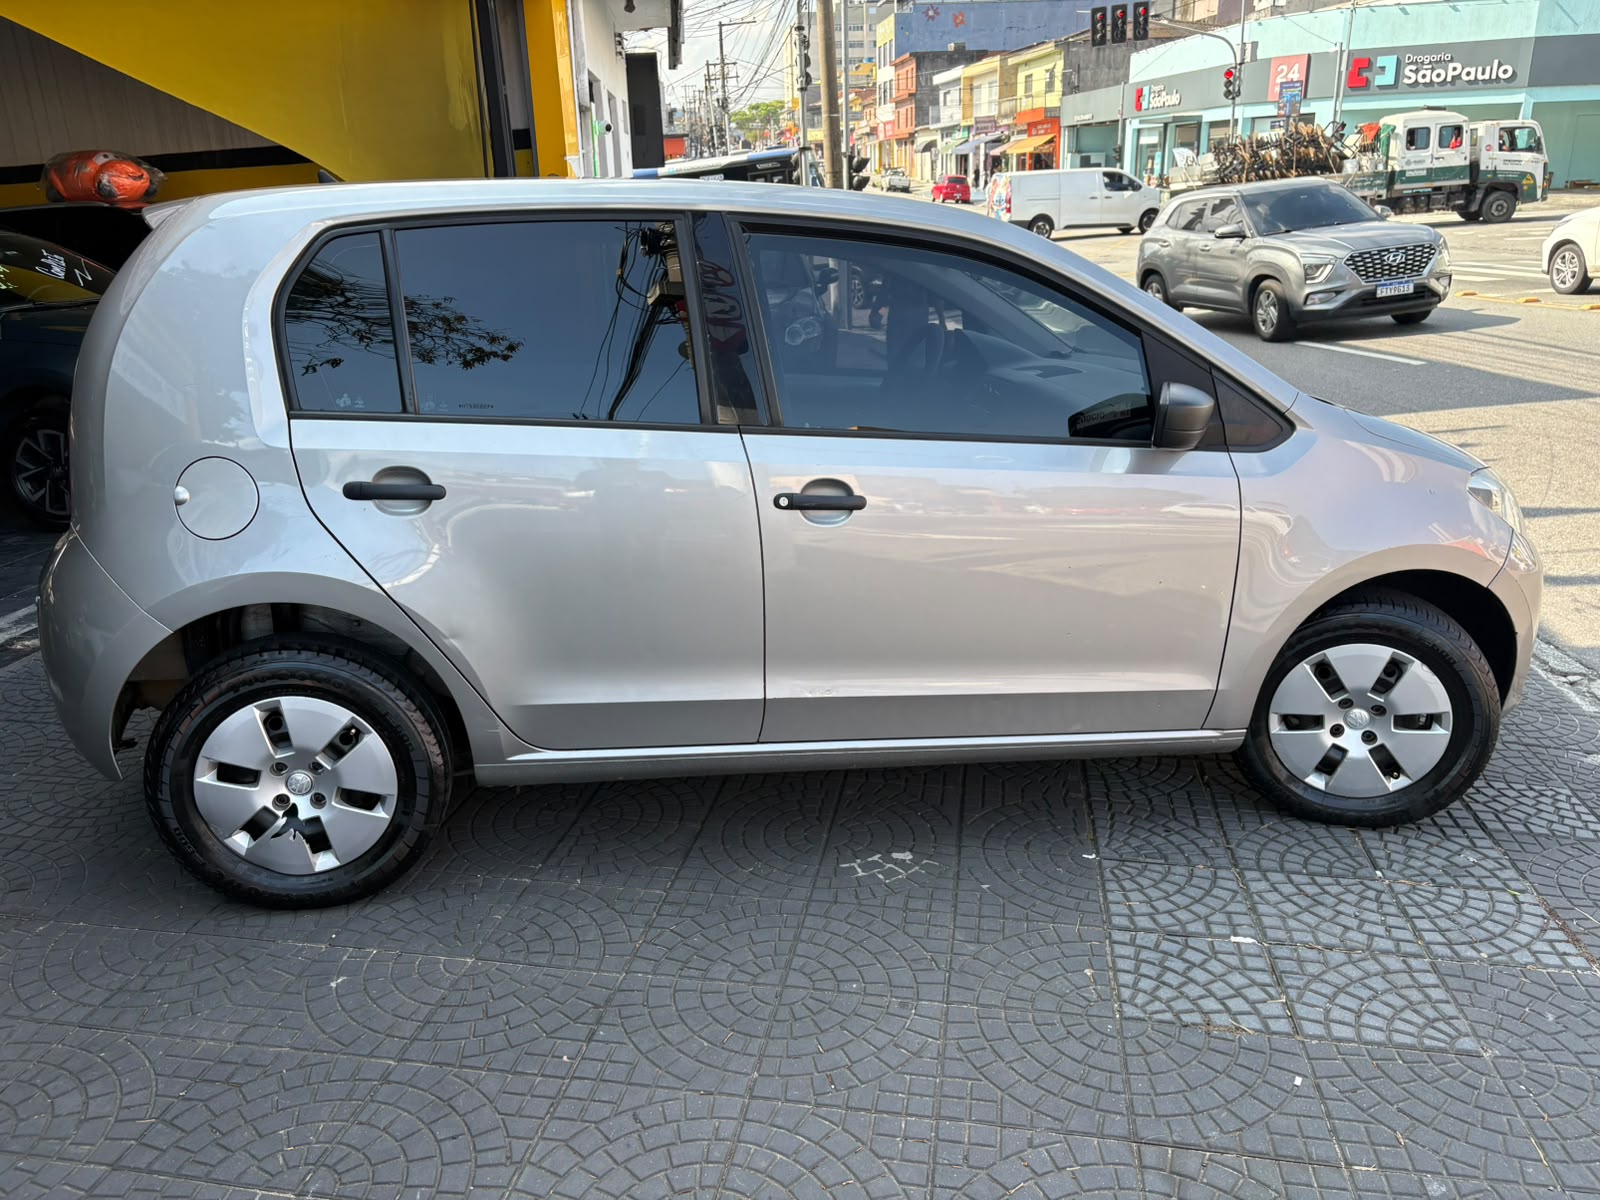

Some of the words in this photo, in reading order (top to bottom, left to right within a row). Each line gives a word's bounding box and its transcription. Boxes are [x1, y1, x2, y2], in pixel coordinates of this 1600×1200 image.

[1405, 52, 1452, 64] Drogaria
[1275, 63, 1300, 84] 24
[1402, 59, 1514, 84] SãoPaulo
